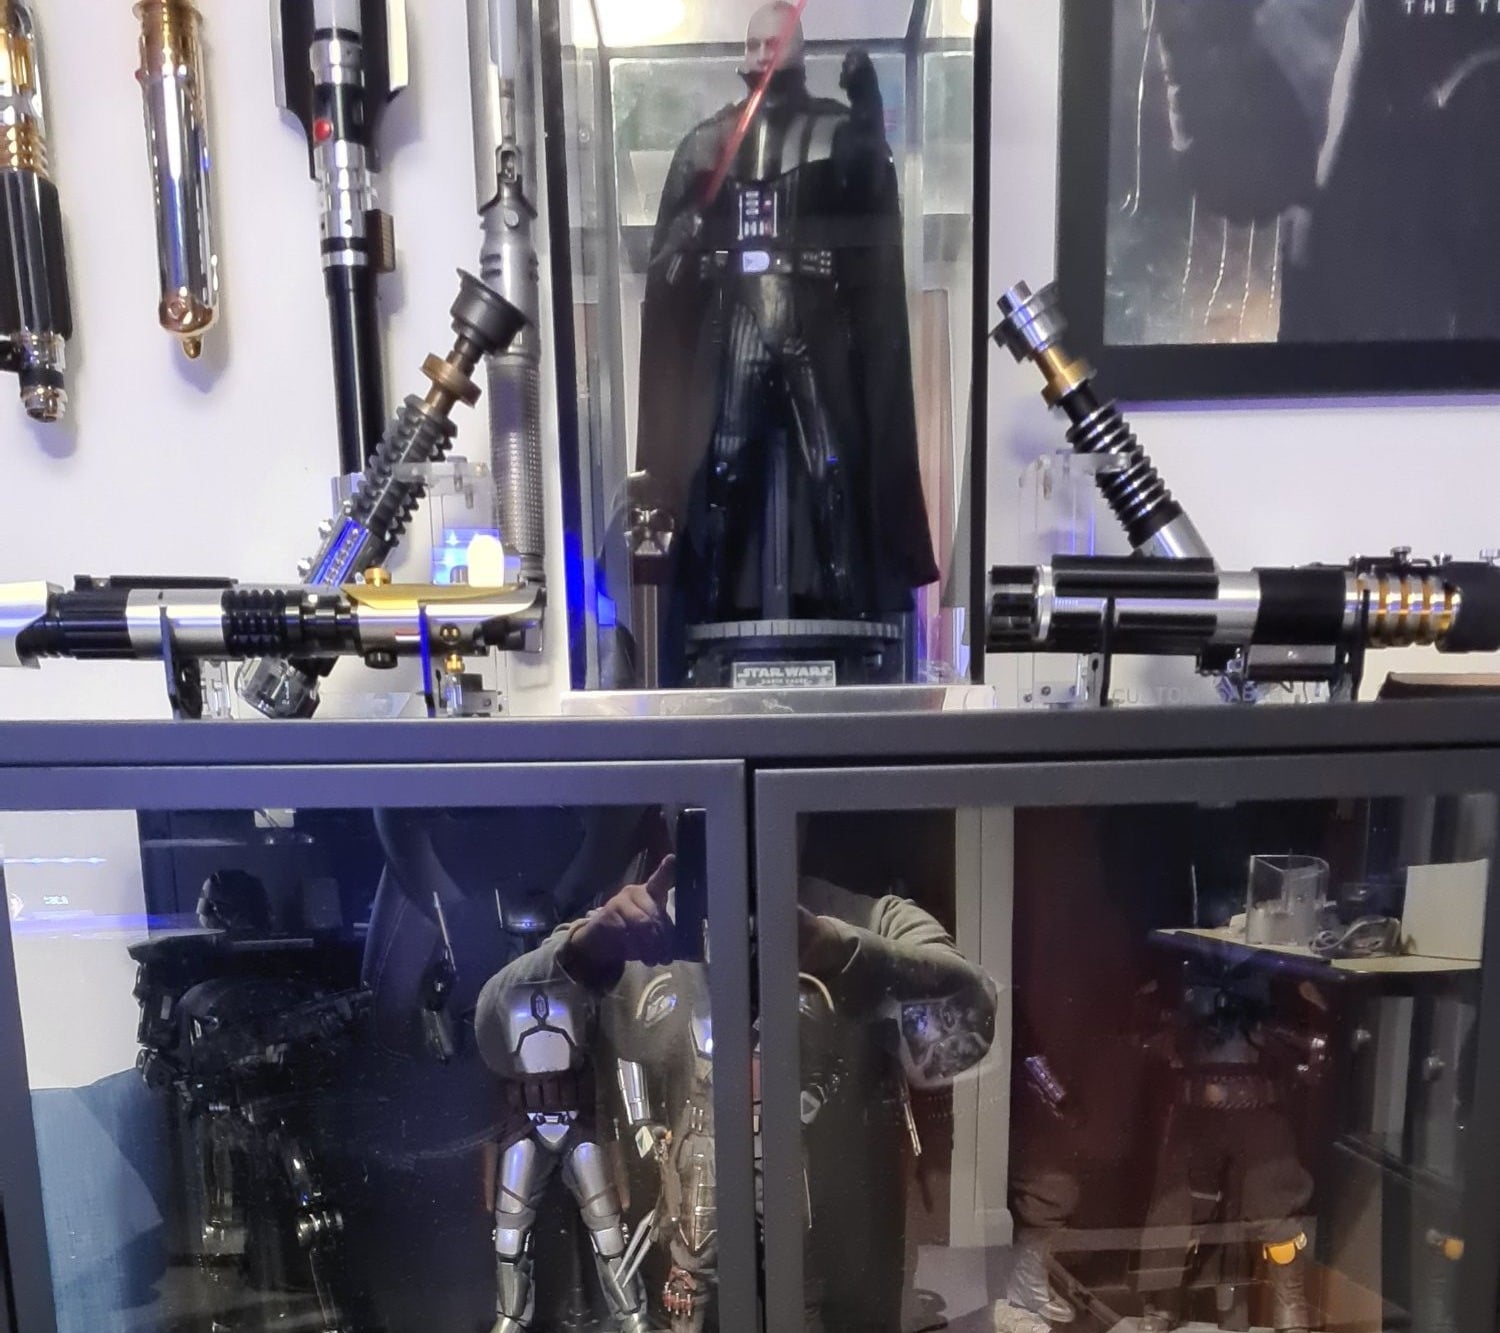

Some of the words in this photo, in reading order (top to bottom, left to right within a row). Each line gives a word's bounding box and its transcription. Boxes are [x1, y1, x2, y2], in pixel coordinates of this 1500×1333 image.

[1404, 0, 1456, 14] THE
[737, 667, 784, 678] STAR
[784, 666, 833, 677] WARS
